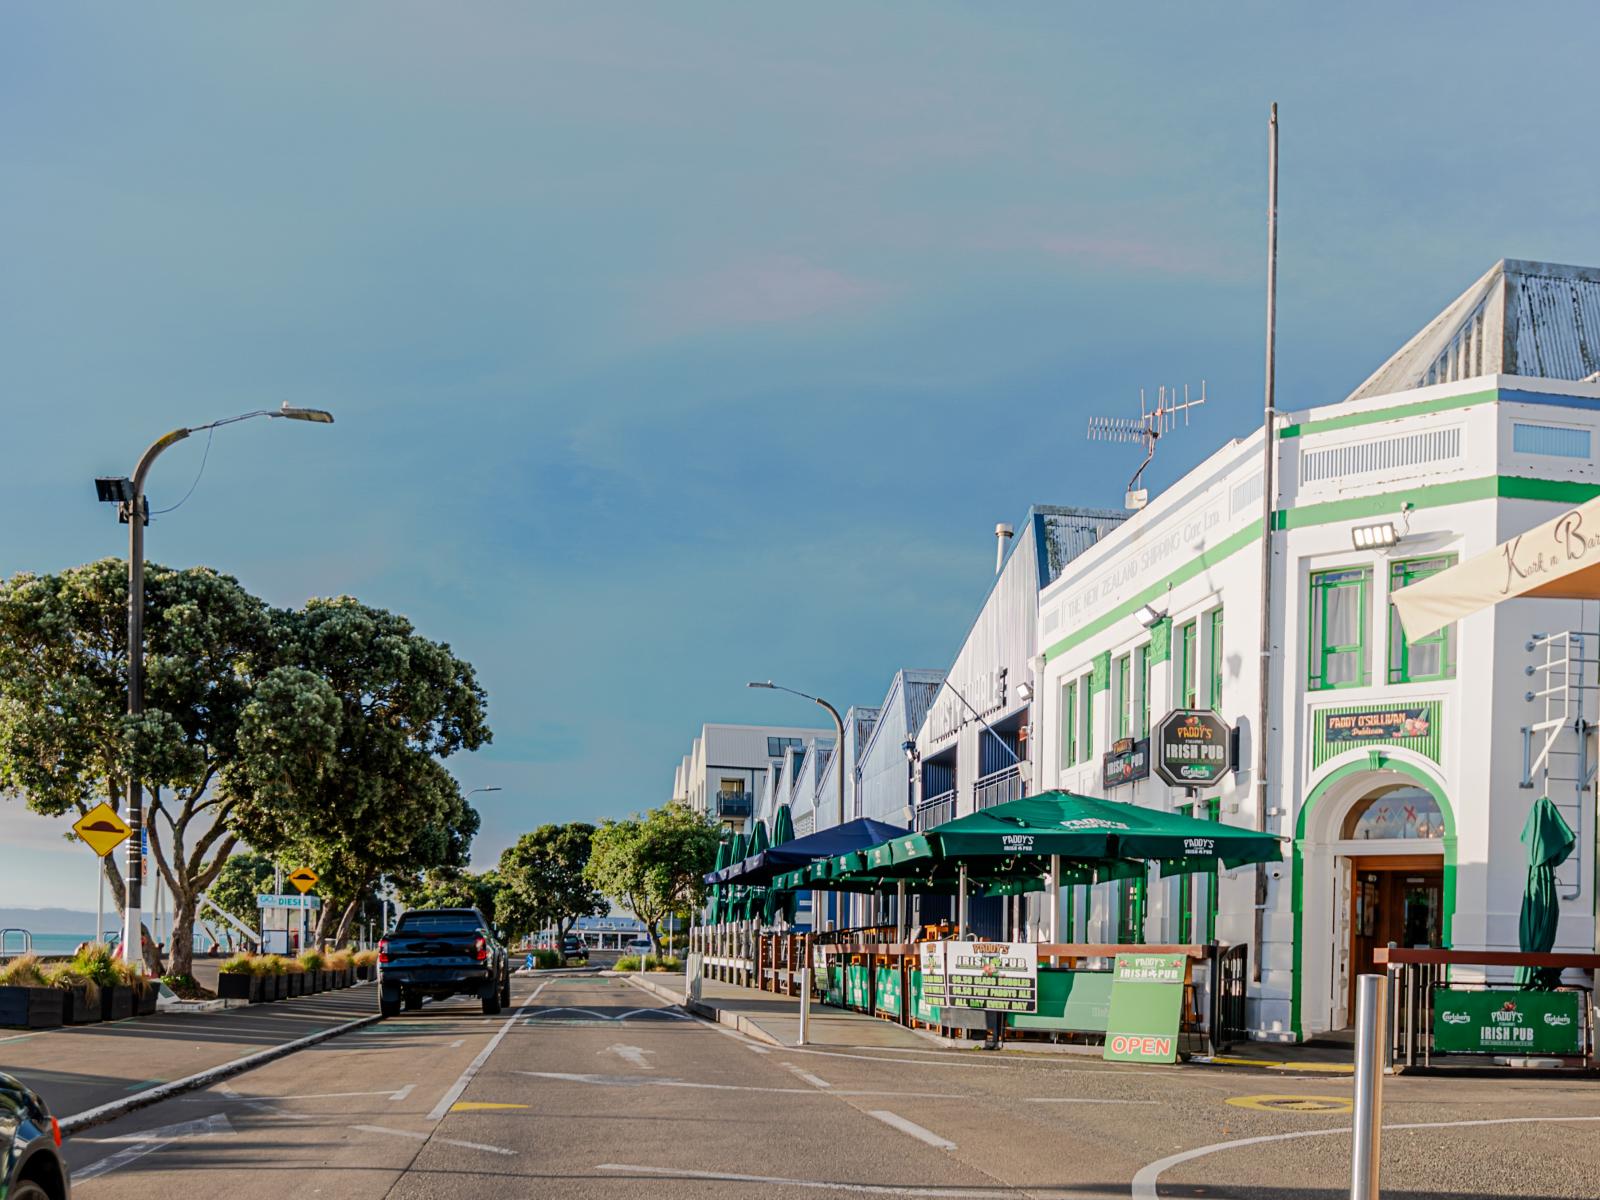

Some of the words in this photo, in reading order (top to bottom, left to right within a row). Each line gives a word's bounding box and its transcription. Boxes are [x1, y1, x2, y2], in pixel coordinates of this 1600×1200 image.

[1102, 557, 1138, 597] ZEALAND
[1329, 716, 1357, 729] PADDY
[1358, 712, 1406, 727] O'SULLIVAN
[1177, 726, 1213, 739] PADDY'S
[1166, 743, 1198, 759] IRISH
[1201, 744, 1224, 760] PUB
[1131, 752, 1144, 769] PUB
[1002, 834, 1035, 845] PADDY'S
[1183, 838, 1215, 849] PADDY'S
[972, 943, 1010, 955] PADDY'S
[1001, 957, 1027, 969] PUB
[1135, 958, 1166, 968] PADDY'S
[1120, 968, 1149, 979] IRISH
[1158, 969, 1178, 979] PUB
[955, 998, 968, 1007] ALL
[970, 998, 984, 1008] DAY
[986, 1000, 1010, 1010] EVERY
[1012, 1001, 1028, 1010] DAY
[1442, 1011, 1471, 1025] Carlsberg
[1491, 1010, 1523, 1023] PADDY'S
[1543, 1012, 1571, 1027] Carlsberg
[1480, 1026, 1510, 1041] IRISH
[1513, 1027, 1534, 1041] PUB
[1111, 1036, 1171, 1056] OPEN
